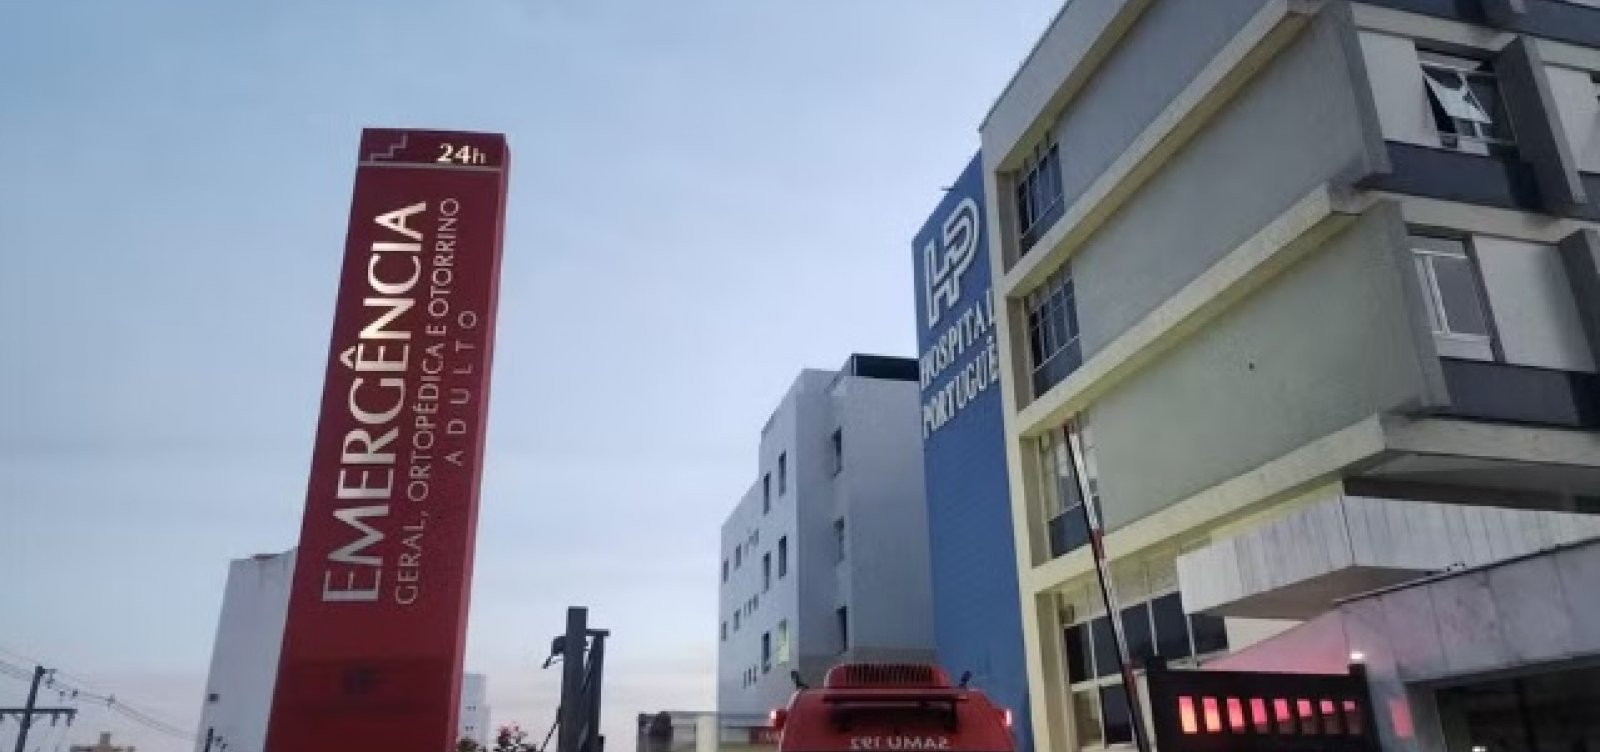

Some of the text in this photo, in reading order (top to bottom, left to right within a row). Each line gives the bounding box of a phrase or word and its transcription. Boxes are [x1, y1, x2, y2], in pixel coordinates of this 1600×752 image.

[437, 143, 486, 164] 24h
[920, 288, 996, 391] HOSPITAL
[922, 335, 999, 440] PORTUGUÊ
[323, 201, 427, 601] EMERGÊNCIA
[395, 197, 460, 605] GERAL, ORTOPÉDICA E OTORRINO
